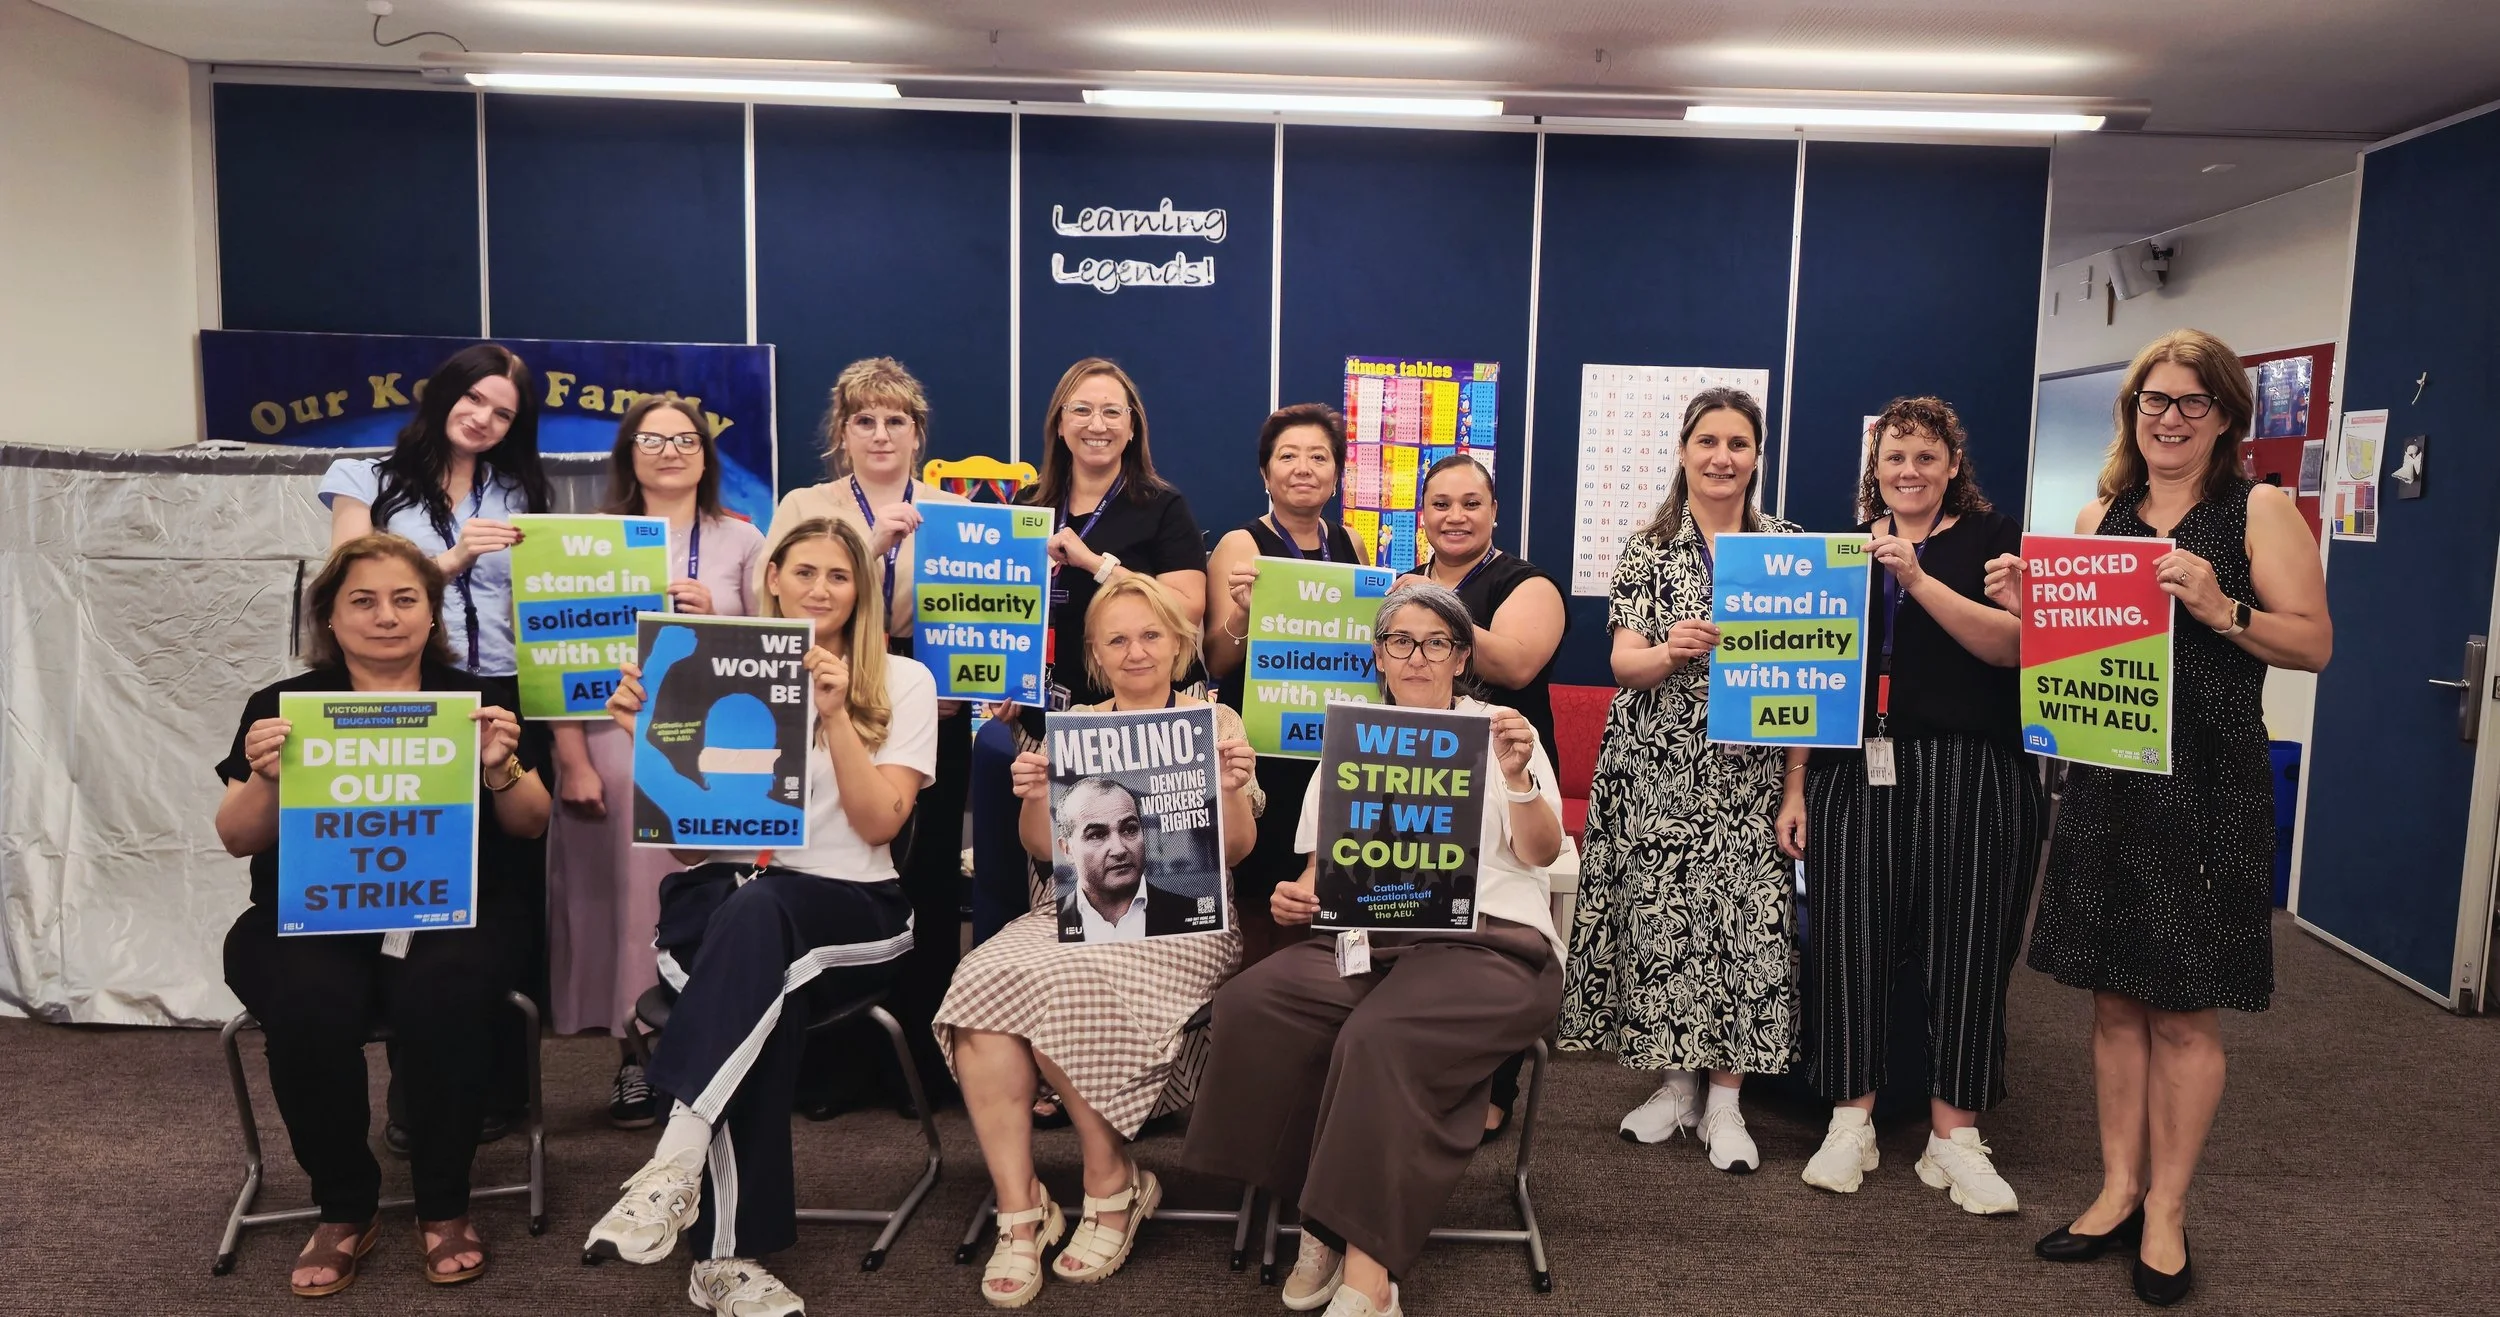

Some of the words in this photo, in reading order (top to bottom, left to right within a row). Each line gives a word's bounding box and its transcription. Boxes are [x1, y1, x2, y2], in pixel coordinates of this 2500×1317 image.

[1055, 201, 1226, 241] Learning
[1056, 253, 1213, 292] Legends!
[1347, 359, 1396, 376] times
[1400, 361, 1453, 378] tables
[1592, 373, 1598, 381] 0
[1664, 375, 1670, 383] 4
[1700, 376, 1706, 384] 6
[1736, 377, 1741, 385] 8
[1590, 391, 1599, 399] 10
[1608, 392, 1616, 400] 11
[1625, 392, 1635, 400] 12
[1644, 393, 1653, 401] 13
[251, 390, 348, 434] Our
[1588, 409, 1598, 417] 20
[1606, 410, 1616, 418] 21
[1624, 410, 1634, 418] 22
[1642, 411, 1652, 419] 23
[1660, 411, 1670, 419] 24
[1605, 428, 1615, 436] 31
[1623, 428, 1633, 436] 32
[1641, 429, 1651, 437] 33
[1659, 429, 1669, 437] 34
[1586, 446, 1596, 454] 40
[1604, 446, 1614, 454] 41
[1640, 447, 1650, 455] 43
[1604, 464, 1613, 472] 51
[1621, 465, 1631, 473] 52
[1639, 465, 1649, 473] 53
[1656, 465, 1667, 473] 54
[1602, 482, 1612, 490] 61
[1620, 483, 1630, 491] 62
[1638, 483, 1648, 491] 63
[1583, 499, 1593, 507] 70
[1602, 500, 1611, 508] 71
[1619, 500, 1629, 508] 72
[1637, 501, 1647, 509] 73
[635, 526, 659, 536] IEU
[1022, 516, 1044, 527] IEU
[1582, 517, 1593, 525] 80
[1618, 518, 1628, 526] 82
[957, 522, 1000, 545] We
[1581, 535, 1592, 543] 90
[1617, 536, 1627, 544] 92
[562, 535, 612, 556] We
[1837, 544, 1861, 554] IEU
[1580, 553, 1593, 561] 100
[1597, 553, 1610, 561] 101
[1763, 554, 1812, 576] We
[2029, 553, 2138, 578] BLOCKED
[924, 556, 1000, 580] stand
[1006, 558, 1030, 582] in
[1578, 570, 1592, 578] 110
[525, 570, 615, 593] stand
[622, 569, 650, 592] in
[1298, 580, 1342, 603] We
[1364, 575, 1386, 587] IEU
[2032, 581, 2097, 603] FROM
[923, 592, 1036, 619] solidarity
[1725, 591, 1813, 614] stand
[1819, 590, 1847, 615] in
[527, 605, 638, 631] solidarit
[1260, 613, 1340, 638] stand
[1346, 618, 1371, 641] in
[2033, 606, 2149, 628] STRIKING.
[761, 634, 802, 655] WE
[924, 624, 984, 648] with
[989, 629, 1030, 652] the
[1722, 628, 1852, 655] solidarity
[531, 641, 600, 665] with
[605, 642, 638, 664] th
[1257, 650, 1374, 678] solidarity
[956, 664, 1000, 682] AEU
[1723, 663, 1789, 688] with
[1797, 667, 1846, 690] the
[2100, 657, 2160, 682] STILL
[770, 685, 801, 704] BE
[1257, 682, 1316, 706] with
[2037, 675, 2159, 708] STANDING
[328, 706, 381, 714] VICTORIAN
[383, 705, 432, 713] CATHOLIC
[1758, 706, 1809, 726] AEU
[2039, 700, 2098, 726] WITH
[2103, 709, 2158, 734] AEU.
[337, 717, 393, 725] EDUCATION
[1053, 718, 1206, 777] MERLINO:
[2029, 734, 2048, 747] IEU
[303, 738, 457, 767] DENIED
[330, 774, 421, 803] OUR
[1150, 769, 1206, 792] DENYING
[1337, 761, 1471, 797] STRIKE
[314, 810, 443, 839] RIGHT
[677, 818, 798, 837] SILENCED!
[1160, 808, 1211, 834] RIGHTS!
[1350, 801, 1383, 830] IF
[1392, 804, 1453, 833] WE
[639, 828, 659, 838] IEU
[350, 846, 407, 874] TO
[1332, 838, 1465, 870] COULD
[304, 879, 449, 912] STRIKE
[1357, 892, 1407, 903] education
[1409, 890, 1432, 899] staff
[1373, 882, 1415, 892] Catholic
[1320, 910, 1338, 920] IEU
[1368, 901, 1396, 911] stand
[1398, 900, 1419, 909] with
[1375, 911, 1391, 919] the
[1393, 910, 1415, 918] AEU.
[283, 922, 304, 931] IEU
[1066, 926, 1083, 935] IEU
